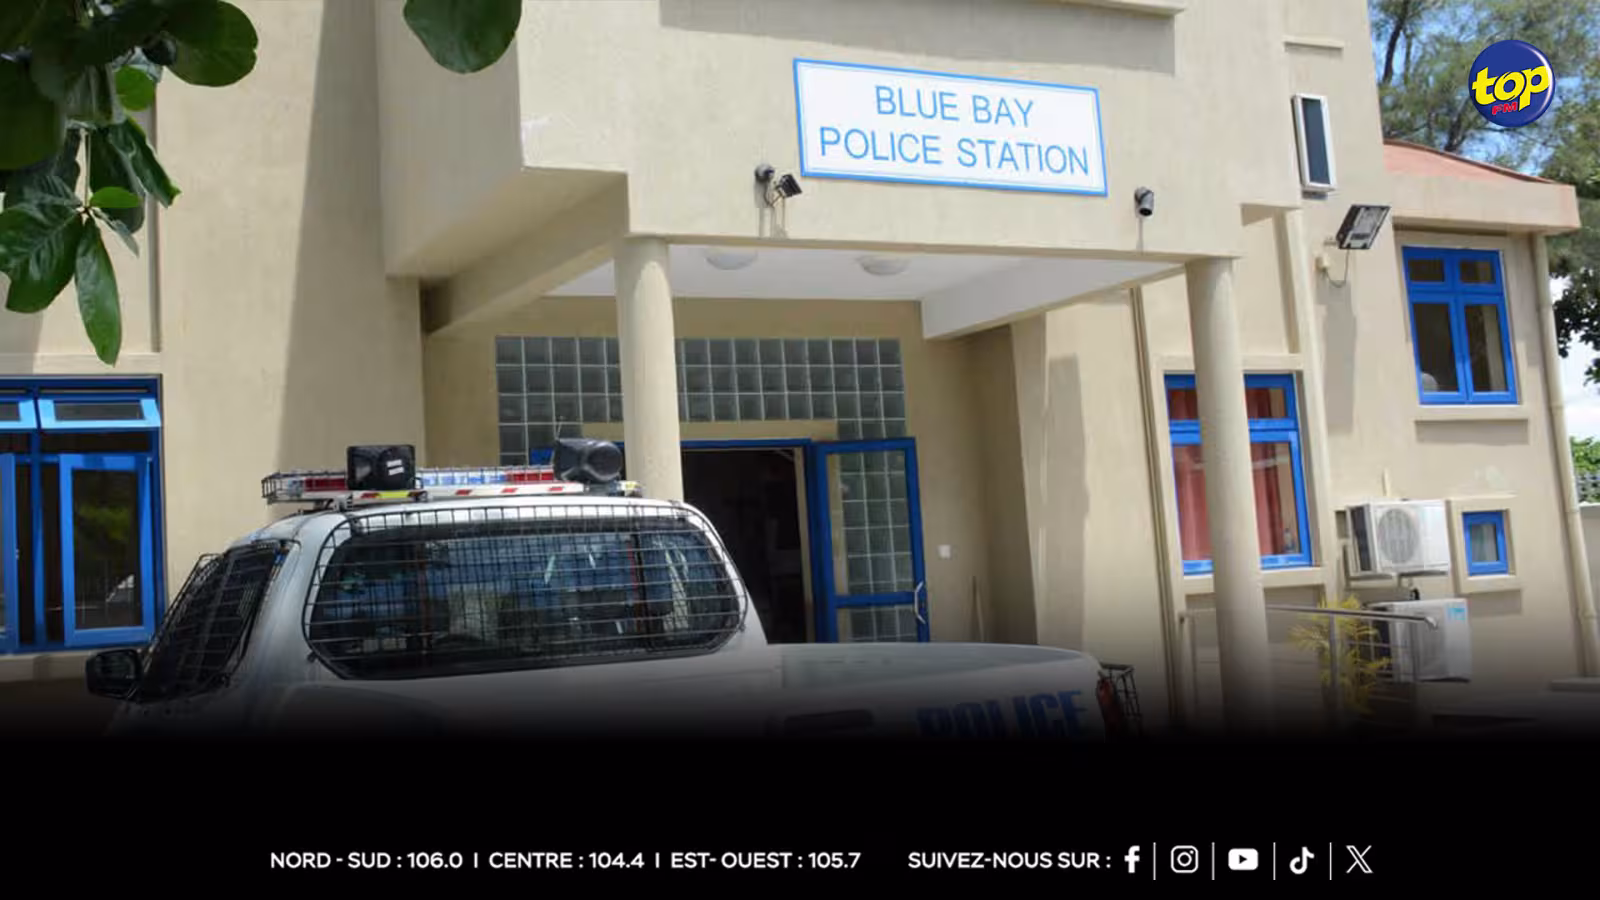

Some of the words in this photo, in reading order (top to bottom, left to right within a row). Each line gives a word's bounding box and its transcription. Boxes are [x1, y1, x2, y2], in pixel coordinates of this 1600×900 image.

[875, 85, 960, 122] BLUE
[972, 94, 1034, 128] BAY
[819, 126, 943, 165] POLICE
[957, 137, 1090, 176] STATION
[916, 690, 1086, 738] POLICE
